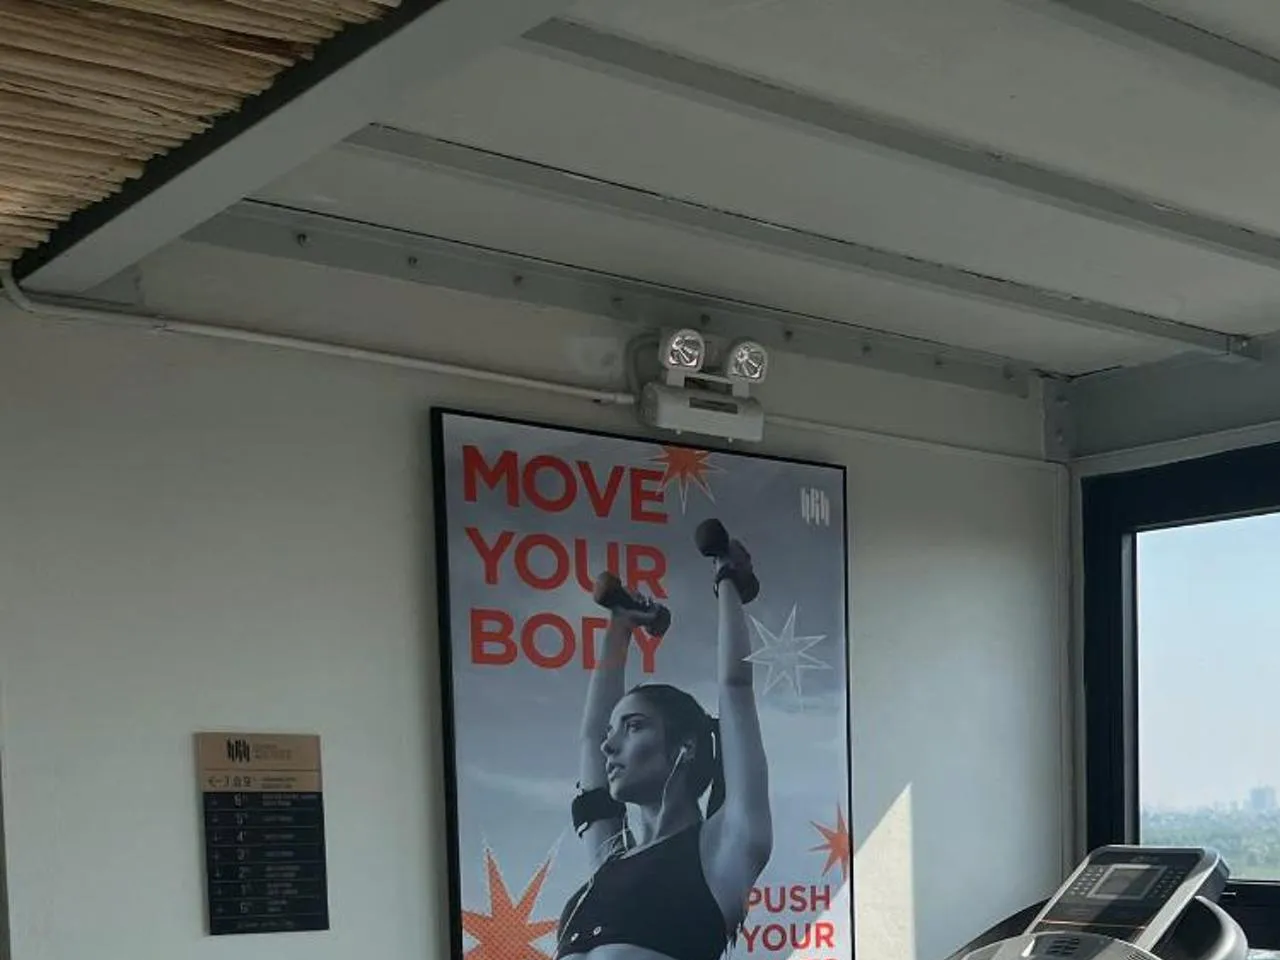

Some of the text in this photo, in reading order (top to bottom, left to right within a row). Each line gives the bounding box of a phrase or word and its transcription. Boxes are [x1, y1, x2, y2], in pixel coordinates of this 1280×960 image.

[463, 445, 668, 523] MOVE
[465, 527, 668, 599] YOUR
[747, 885, 830, 913] PUSH
[742, 922, 835, 953] YOUR
